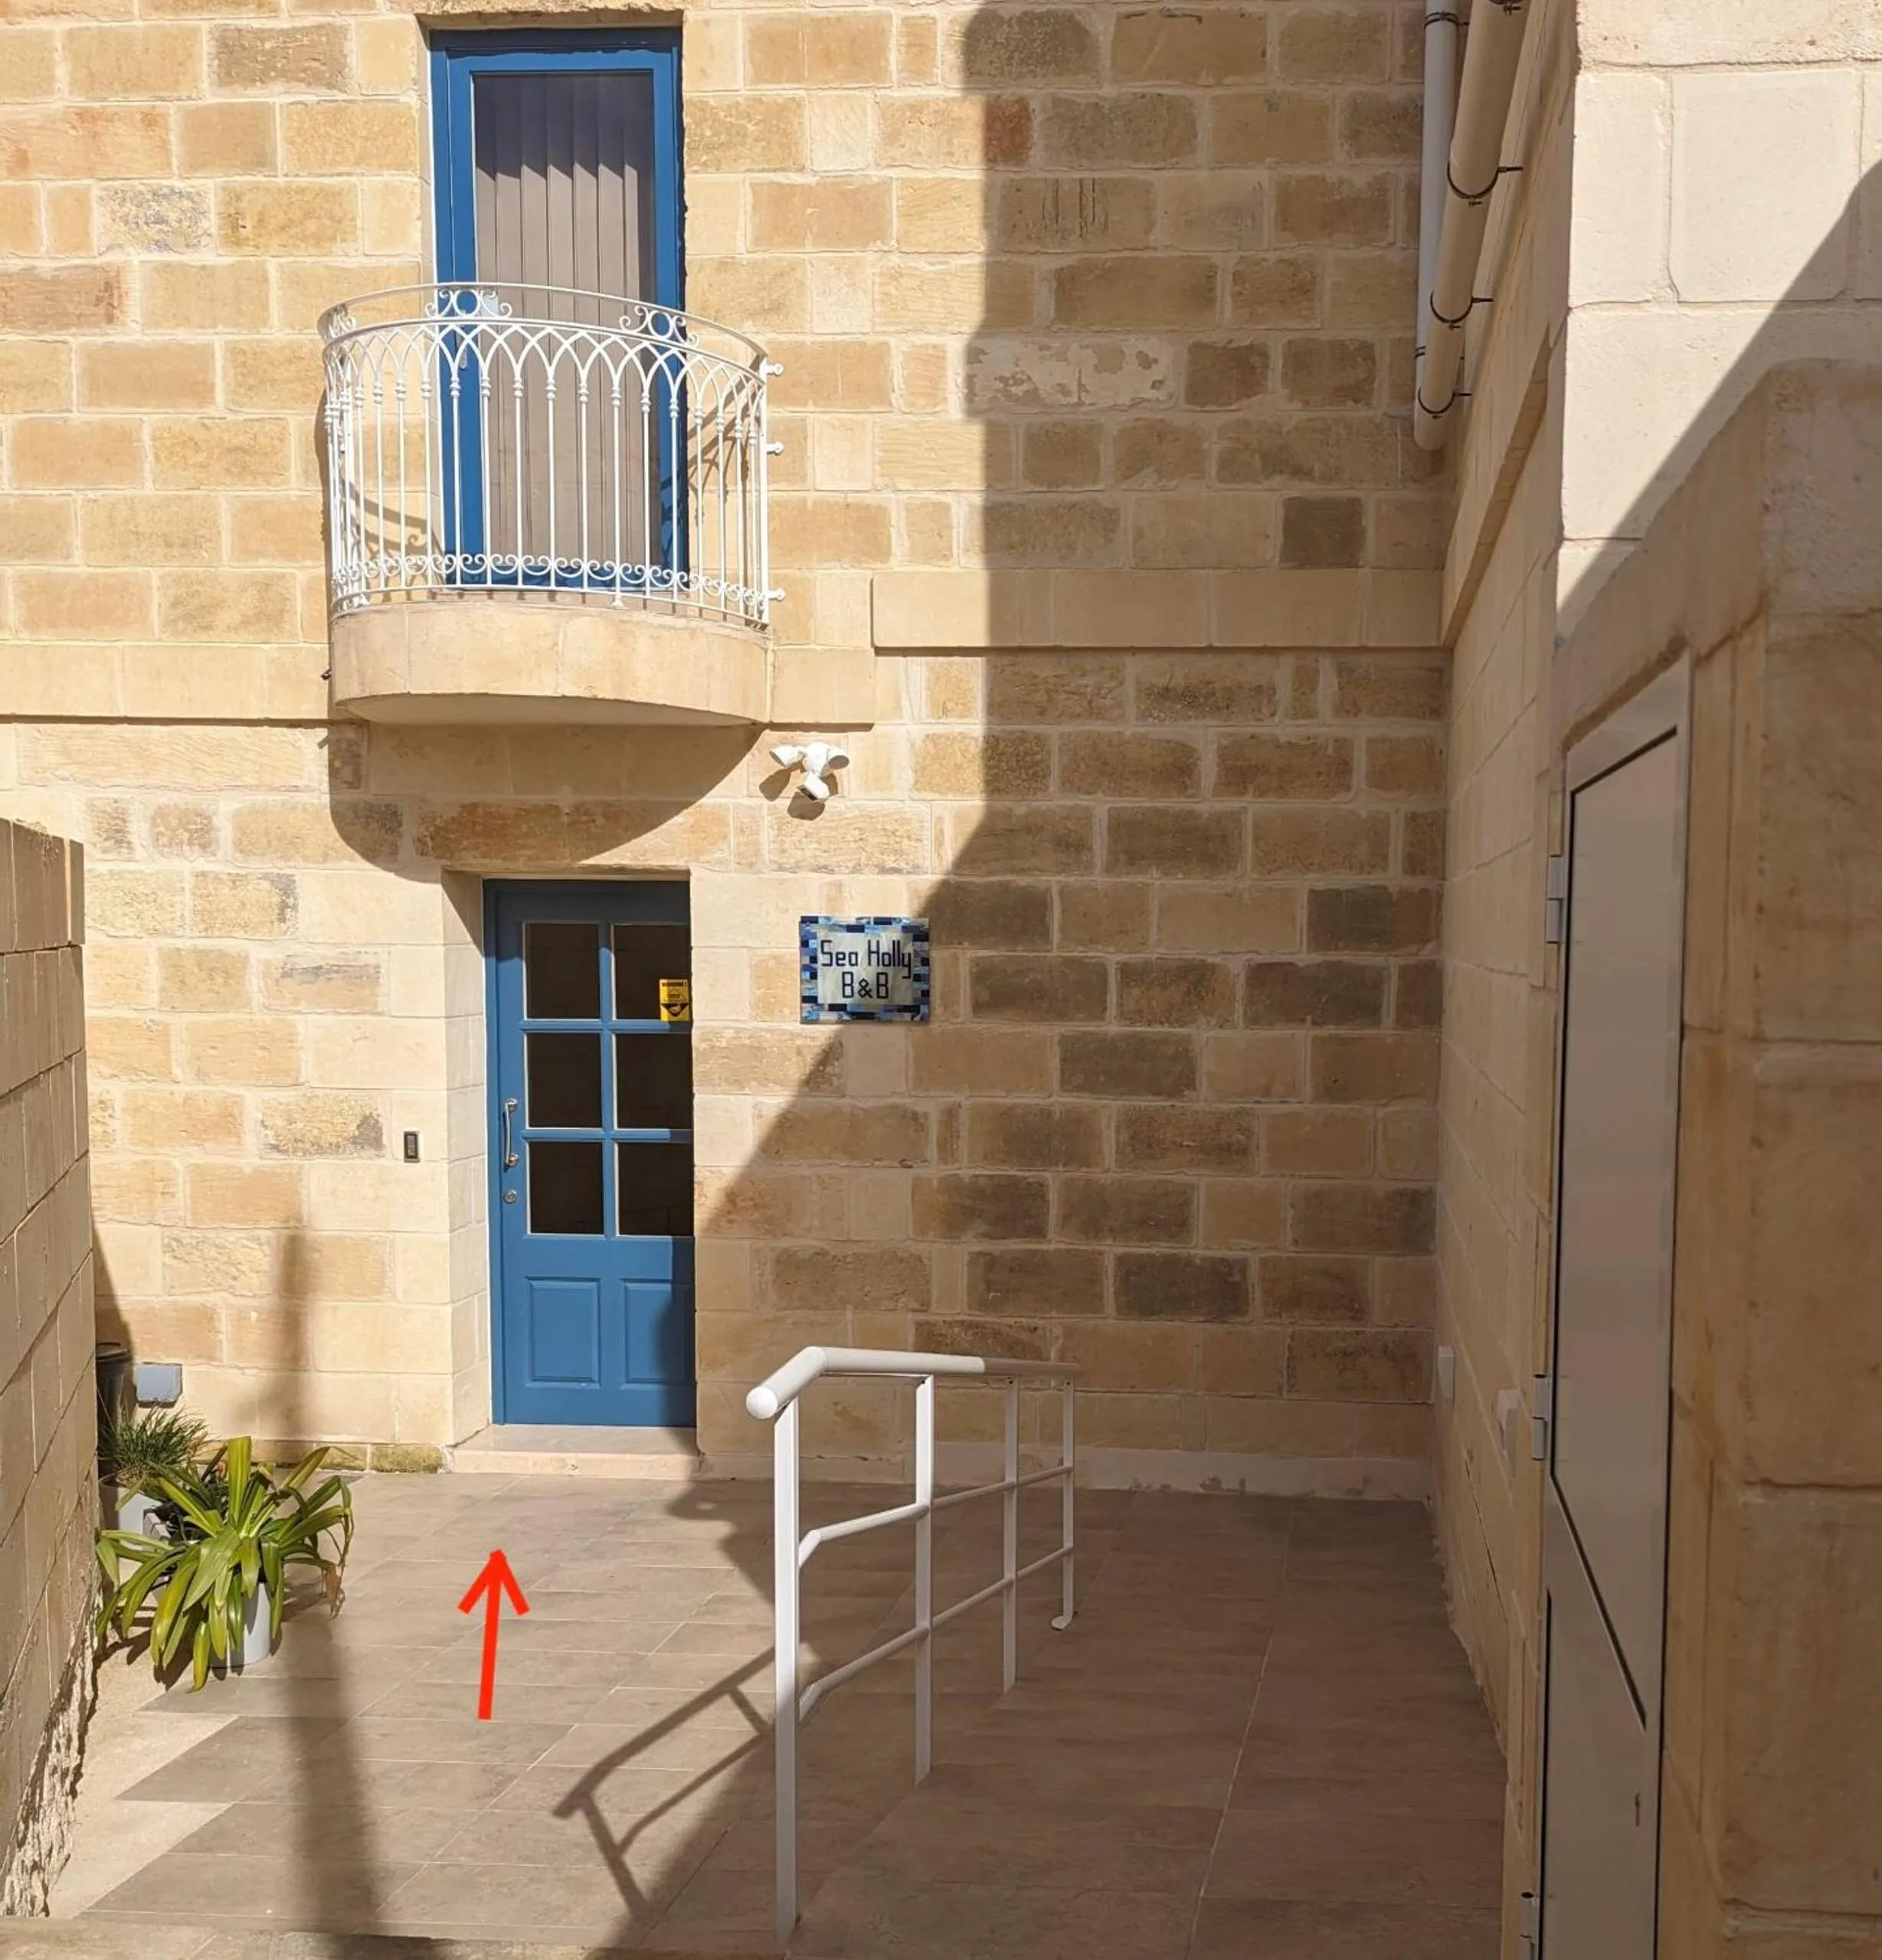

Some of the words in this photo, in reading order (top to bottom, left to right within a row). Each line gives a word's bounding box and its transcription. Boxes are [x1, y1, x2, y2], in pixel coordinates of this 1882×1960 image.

[820, 939, 859, 967] Sea
[867, 939, 912, 980] Holly
[841, 971, 889, 999] B&B
